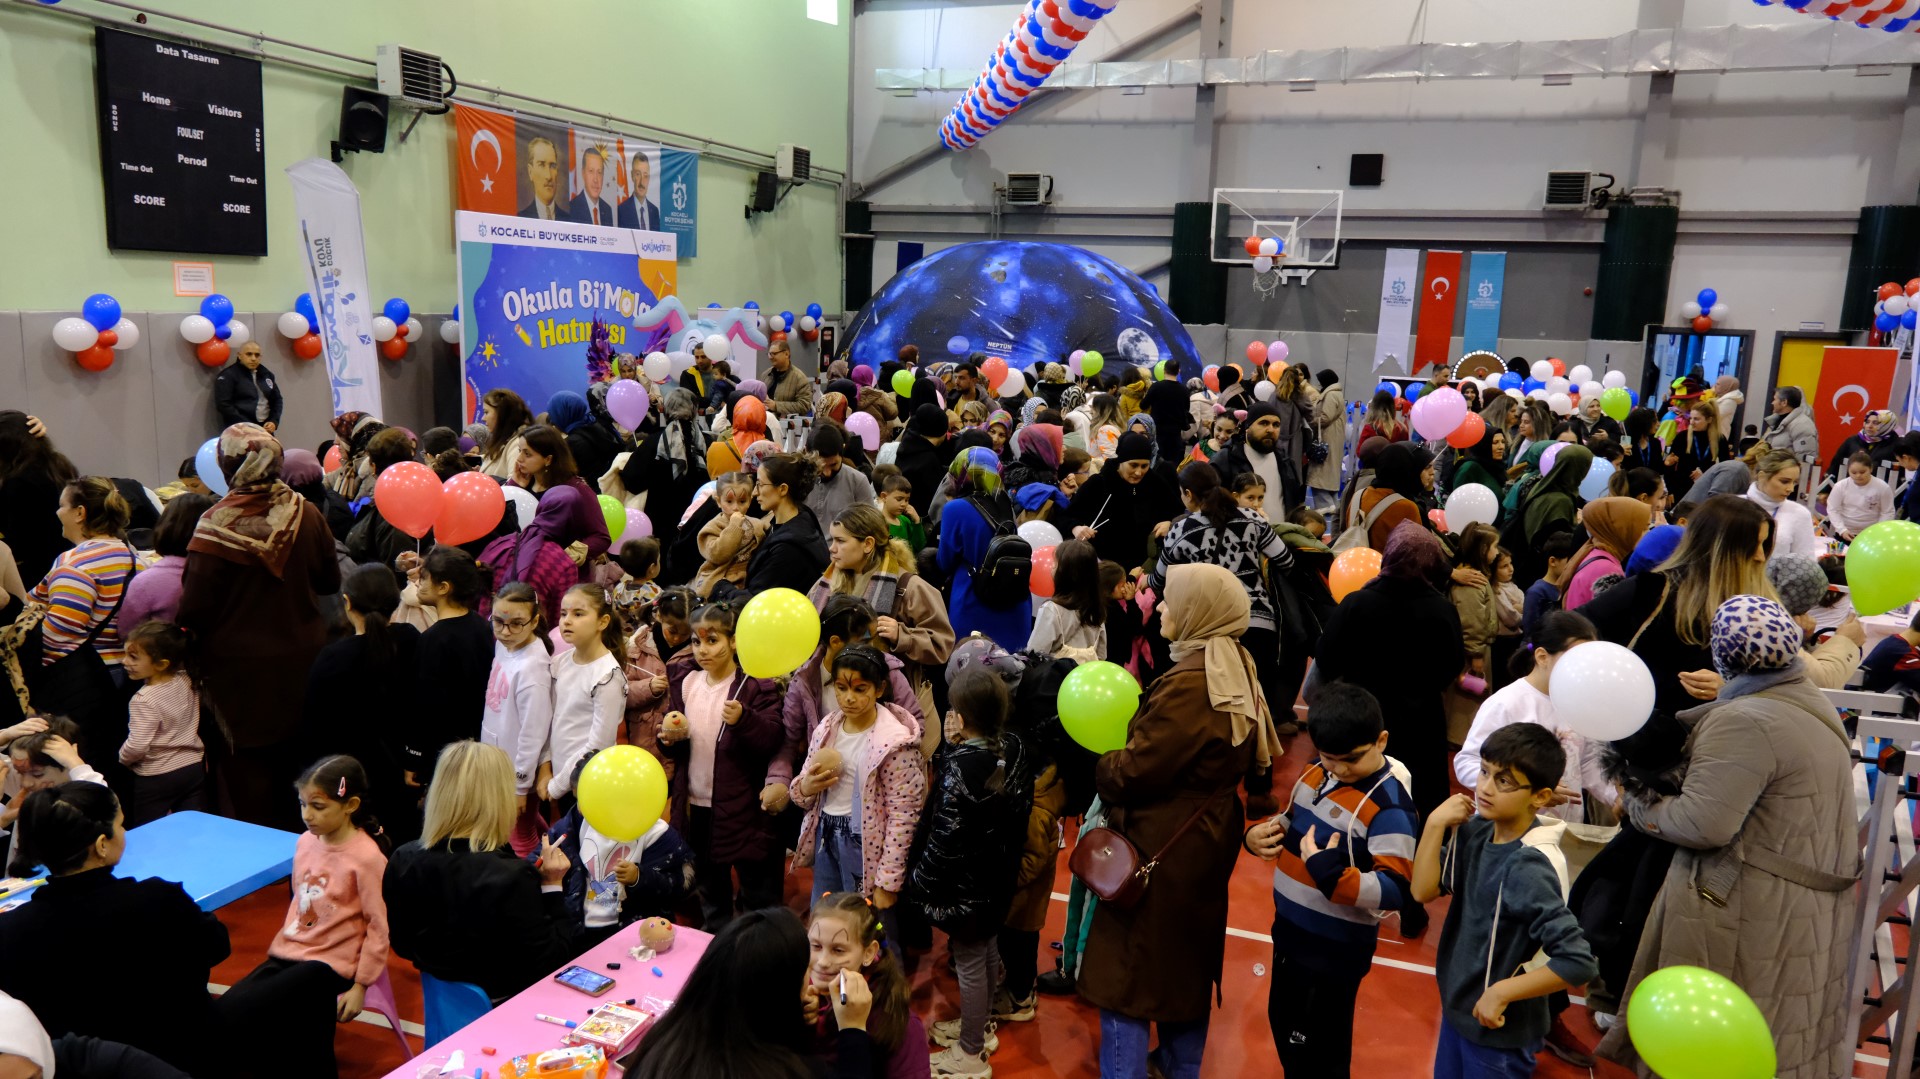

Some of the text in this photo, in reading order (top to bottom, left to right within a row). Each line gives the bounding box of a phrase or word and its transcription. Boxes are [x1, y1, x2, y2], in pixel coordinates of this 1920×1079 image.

[156, 44, 219, 65] Data Tasarım
[142, 91, 171, 106] Home
[208, 104, 242, 118] Visitors
[120, 162, 153, 173] Time Out
[177, 154, 207, 167] Period
[229, 175, 258, 185] Time Out
[134, 194, 166, 206] SCORE
[223, 203, 251, 214] SCORE
[490, 226, 598, 245] KOCAELİ BÜYÜKŞEHİR
[503, 281, 574, 322] Okula
[537, 317, 626, 349] Hatırsı
